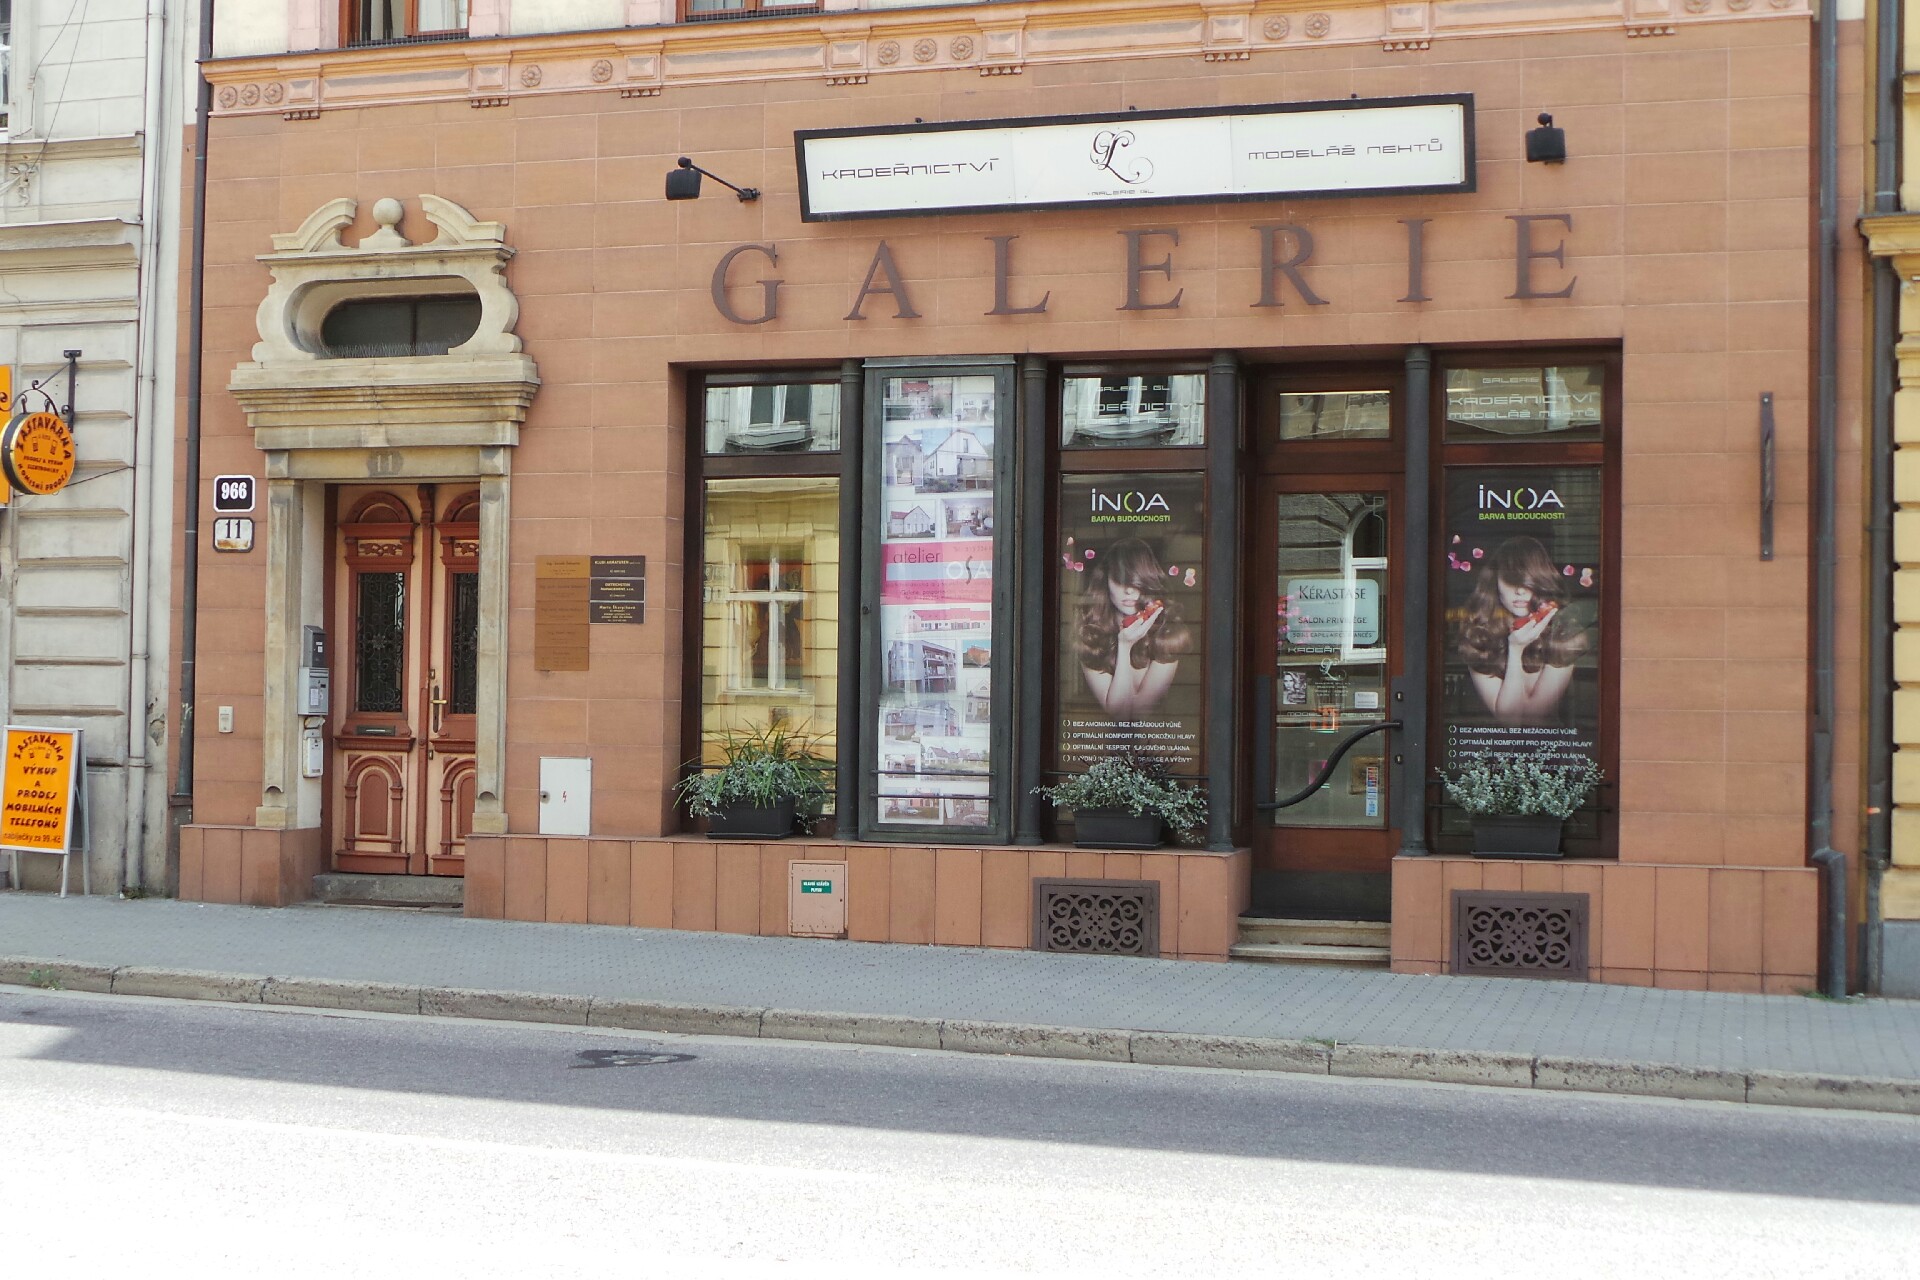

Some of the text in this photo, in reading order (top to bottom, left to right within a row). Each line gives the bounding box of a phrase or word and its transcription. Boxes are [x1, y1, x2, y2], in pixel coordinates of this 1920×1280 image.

[1249, 138, 1442, 160] MODELÁŽ NEHTŮ
[822, 158, 999, 180] KADEŘNICTVÍ
[710, 213, 1577, 327] GALERIE
[1450, 392, 1598, 406] KADEŘNICTVÍ
[1449, 409, 1531, 419] MODELÁŽ
[377, 454, 393, 473] 11
[221, 482, 247, 500] 966
[1091, 514, 1171, 523] BARVA BUDOUCNOSTI
[1479, 512, 1565, 520] BARVA BUDOUCNOSTI
[225, 519, 242, 539] 11
[893, 547, 941, 563] atelier
[1131, 720, 1165, 728] NEŽÁDOUCÍ
[1523, 727, 1559, 735] NEŽÁDOUCÍ
[1459, 738, 1493, 746] OPTIMÁLNÍ
[23, 763, 57, 775] VÝKUP
[17, 789, 57, 799] PRODEJ
[5, 803, 62, 815] MOBILNÍCH
[10, 817, 58, 829] TELEFONŮ
